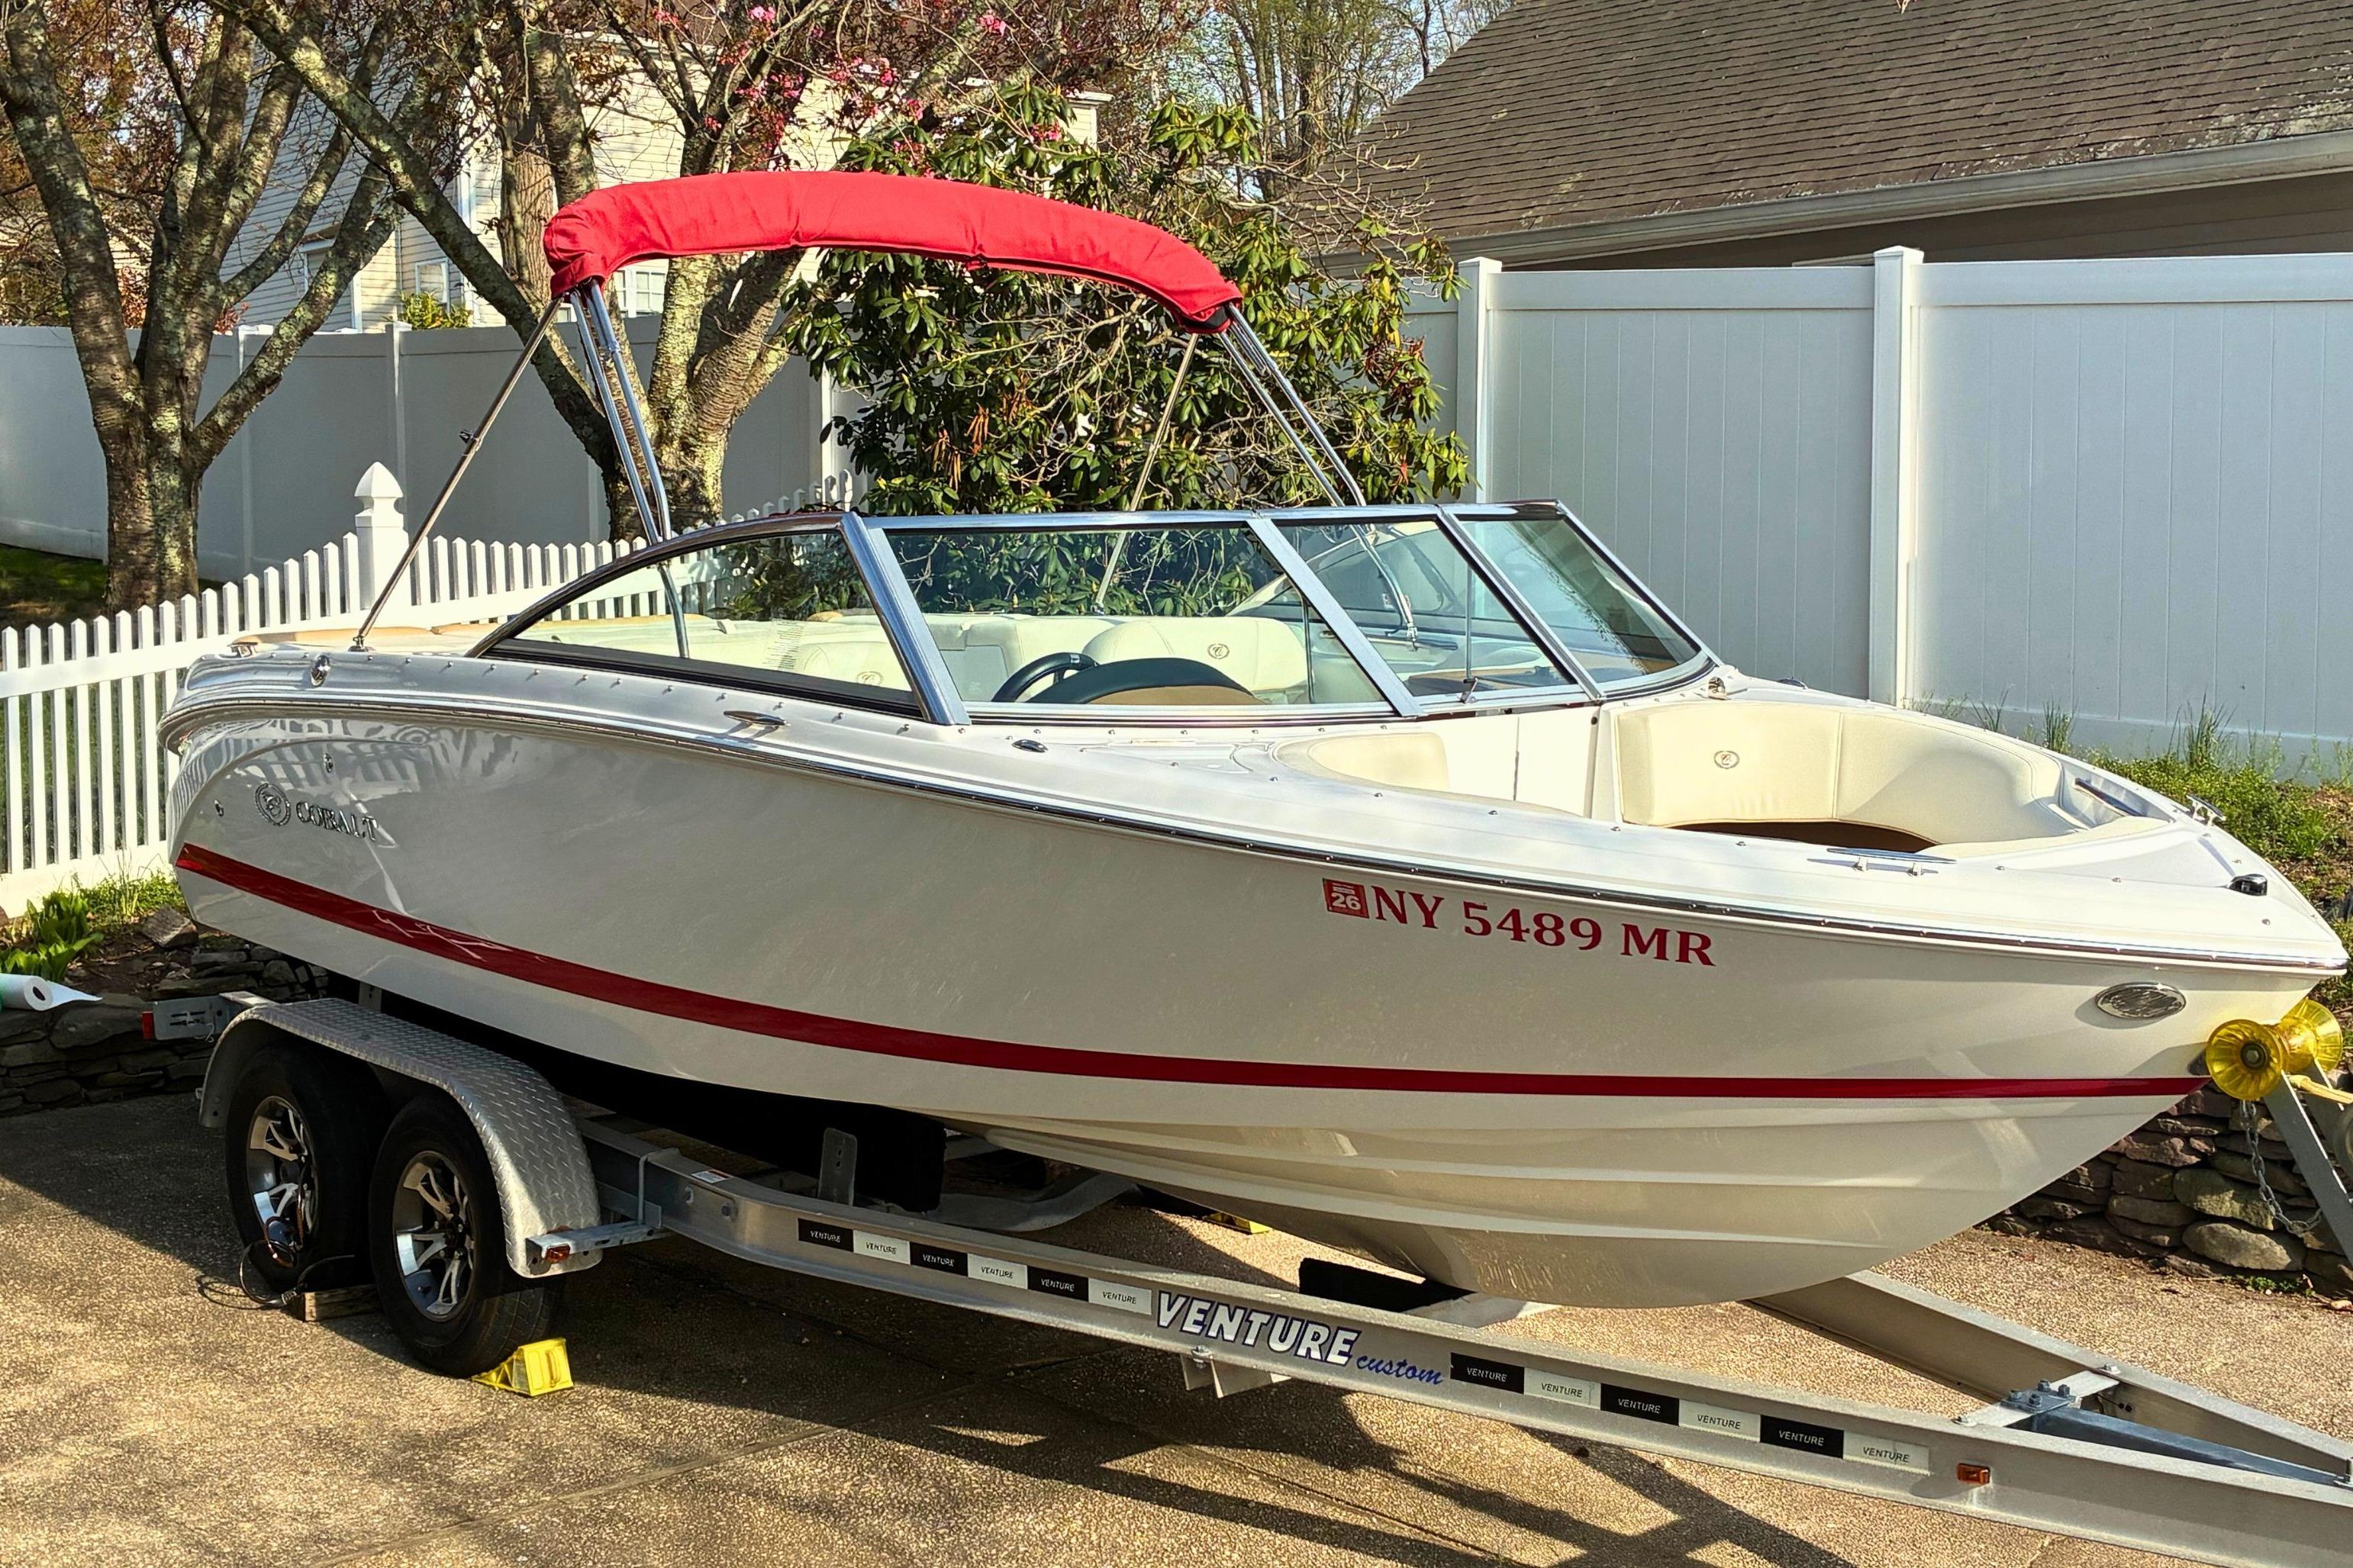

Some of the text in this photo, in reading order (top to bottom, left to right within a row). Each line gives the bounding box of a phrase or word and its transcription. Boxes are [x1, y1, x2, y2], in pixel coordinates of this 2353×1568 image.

[296, 802, 379, 842] COBALT
[1331, 892, 1362, 910] 26
[1371, 885, 1716, 967] NY 5489 MR
[811, 1230, 840, 1243] VENTURE
[865, 1241, 897, 1254] VENTURE
[922, 1253, 954, 1267] VENTURE
[981, 1266, 1014, 1280] VENTURE
[1040, 1278, 1075, 1292] VENTURE
[1102, 1291, 1136, 1305] VENTURE
[1157, 1290, 1444, 1386] VENTURE custom
[1466, 1367, 1508, 1383] VENTURE
[1540, 1382, 1583, 1399] VENTURE
[1617, 1398, 1661, 1415] VENTURE
[1696, 1414, 1742, 1431] VENTURE
[1778, 1429, 1825, 1447] VENTURE
[1862, 1446, 1910, 1464] VENTURE
